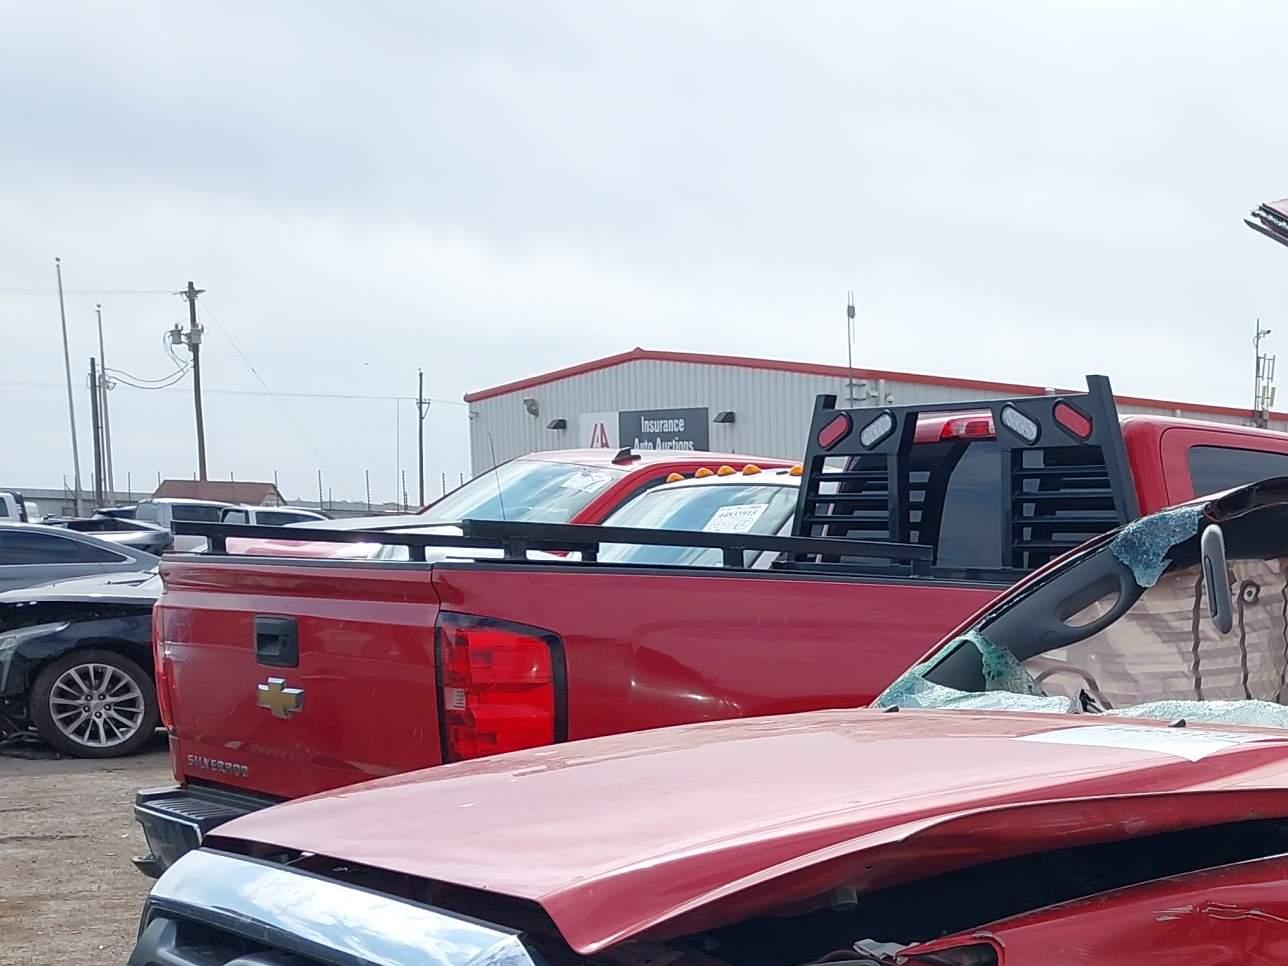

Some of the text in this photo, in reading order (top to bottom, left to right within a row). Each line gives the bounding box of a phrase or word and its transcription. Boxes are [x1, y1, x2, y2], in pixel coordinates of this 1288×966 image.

[641, 416, 685, 433] Insurance
[634, 437, 694, 450] Auto Auctions
